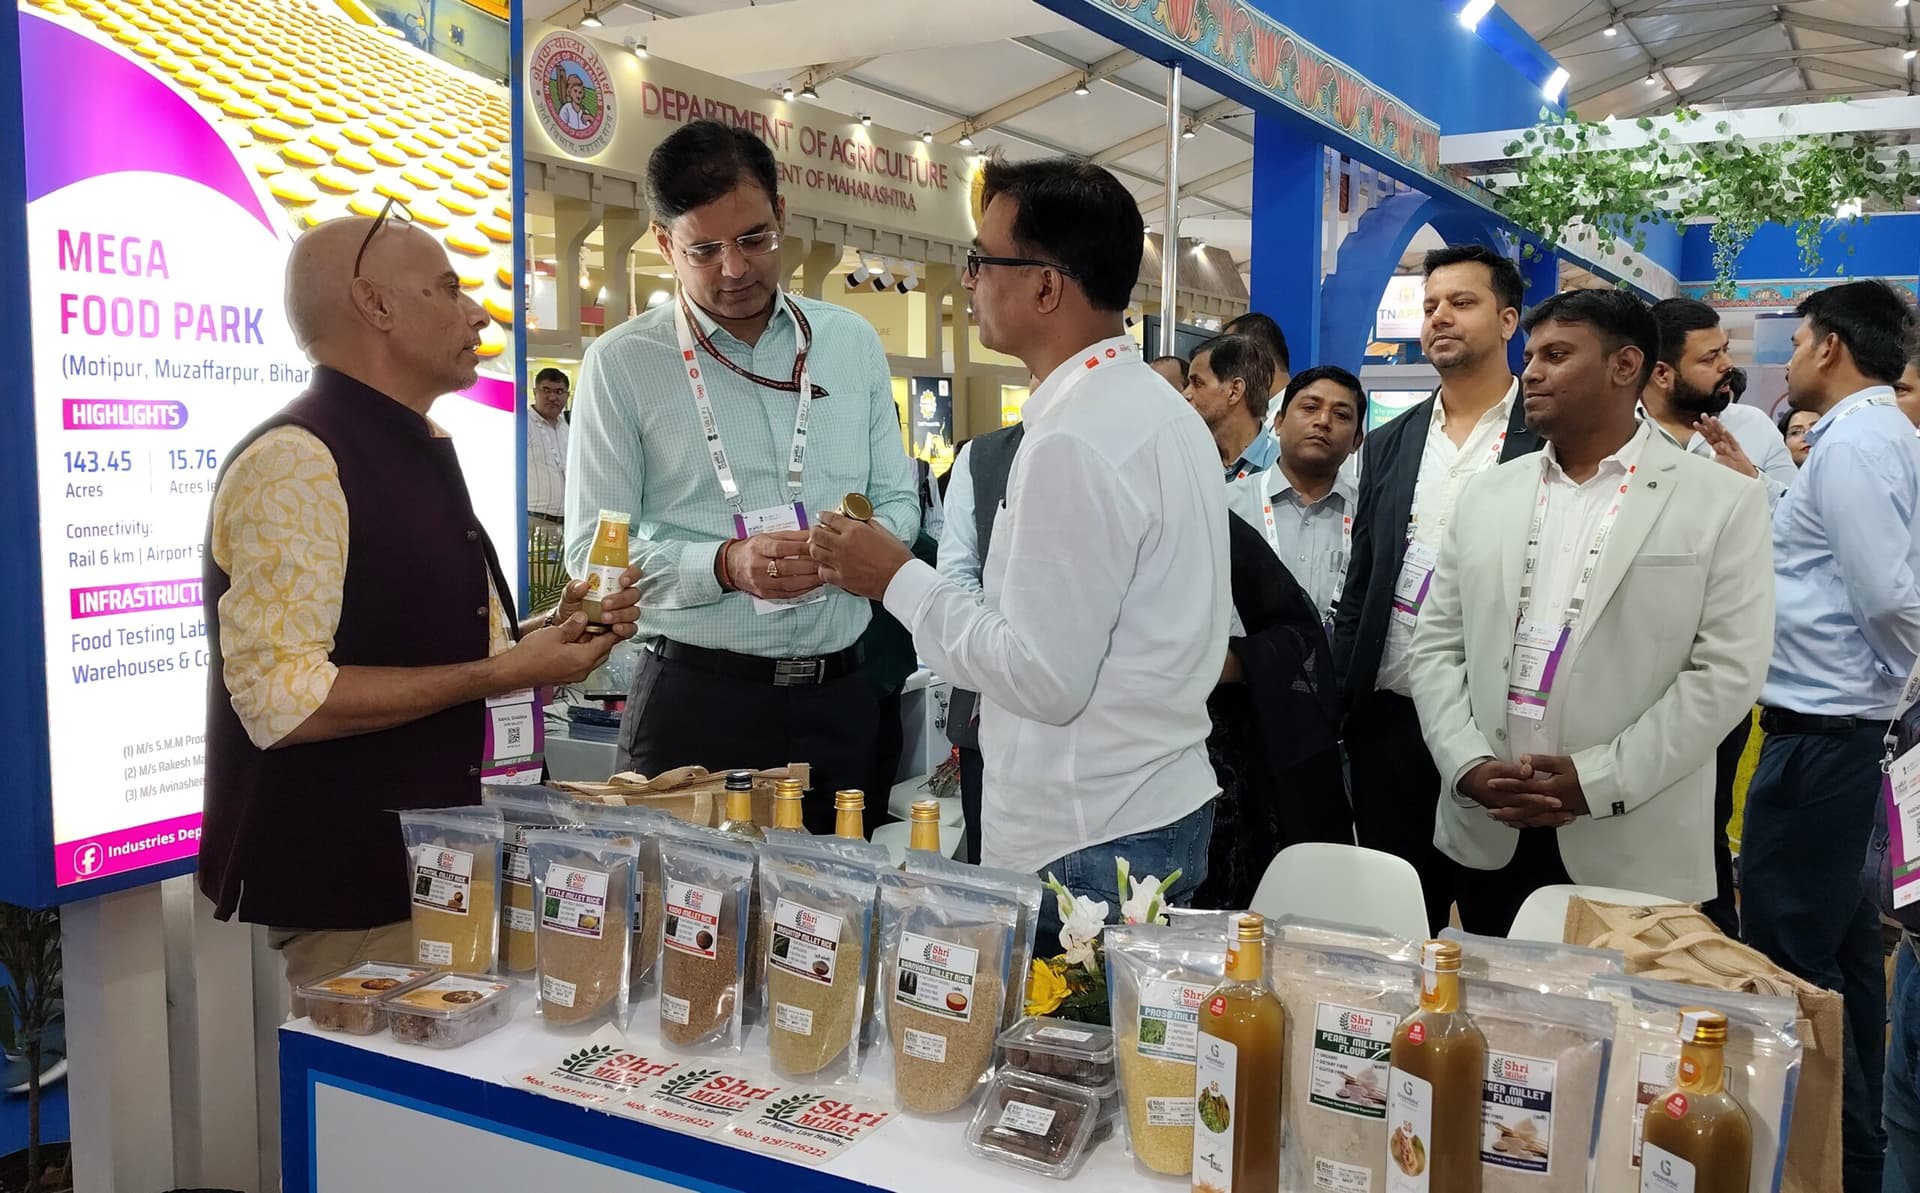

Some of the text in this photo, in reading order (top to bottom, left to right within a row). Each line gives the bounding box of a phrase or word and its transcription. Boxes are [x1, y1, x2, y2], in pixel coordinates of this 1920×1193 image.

[641, 81, 948, 190] DEPARTMENT OF AGRICULTURE
[806, 169, 825, 189] OF
[827, 174, 917, 212] MAHARASHTRA
[58, 229, 170, 279] MEGA
[60, 293, 264, 345] FOOD PARK
[62, 353, 149, 381] (Motipur,
[155, 358, 264, 385] Muzaffarpur,
[71, 403, 181, 427] HIGHLIGHTS
[63, 449, 217, 473] 143.45 15.76
[66, 483, 104, 498] Acres
[170, 480, 203, 494] Acres
[66, 520, 153, 539] Connectivity:
[69, 550, 96, 568] Rail
[100, 550, 109, 565] 6
[113, 548, 135, 564] km
[147, 544, 193, 563] Airport
[71, 629, 112, 653] Food
[117, 624, 175, 646] Testing
[72, 657, 174, 684] Warehouses
[179, 652, 190, 669] &
[123, 744, 134, 759] (1)
[136, 740, 154, 756] M/s
[155, 735, 184, 752] S.M.M
[124, 767, 136, 781] (2)
[139, 763, 157, 777] M/s
[158, 757, 191, 773] Rakesh
[125, 788, 138, 803] (3)
[139, 784, 157, 798] M/s
[108, 832, 176, 858] Industries
[547, 888, 601, 905] LITTLE MILLET RICE
[682, 909, 701, 920] MILLET
[802, 911, 817, 924] Shri
[801, 932, 820, 946] MILLET
[820, 940, 833, 950] RICE
[932, 944, 949, 957] Shri
[930, 966, 954, 980] MILLET
[954, 974, 970, 983] RICE
[1183, 988, 1206, 1000] Shri
[1183, 999, 1201, 1008] Mille
[1144, 1007, 1197, 1023] PROSO MILL
[1350, 1014, 1373, 1028] Shri
[1351, 1024, 1372, 1034] Millet
[1322, 1032, 1385, 1051] PEARL MILLET
[1338, 1044, 1367, 1058] FLOUR
[550, 1071, 563, 1079] Eat
[605, 1054, 680, 1078] Shri
[1504, 1060, 1529, 1074] Shri
[1504, 1070, 1527, 1081] Millet
[590, 1066, 649, 1086] Millet
[703, 1075, 781, 1101] Shri
[1509, 1087, 1545, 1101] MILLET
[650, 1093, 665, 1101] Eat
[687, 1102, 702, 1111] Live
[688, 1089, 750, 1110] Millet
[1493, 1093, 1523, 1107] FLOUR
[808, 1099, 889, 1128] Shri
[756, 1118, 770, 1126] Eat
[796, 1128, 814, 1137] Live
[793, 1113, 862, 1137] Millet
[760, 1135, 828, 1158] 9297736222
